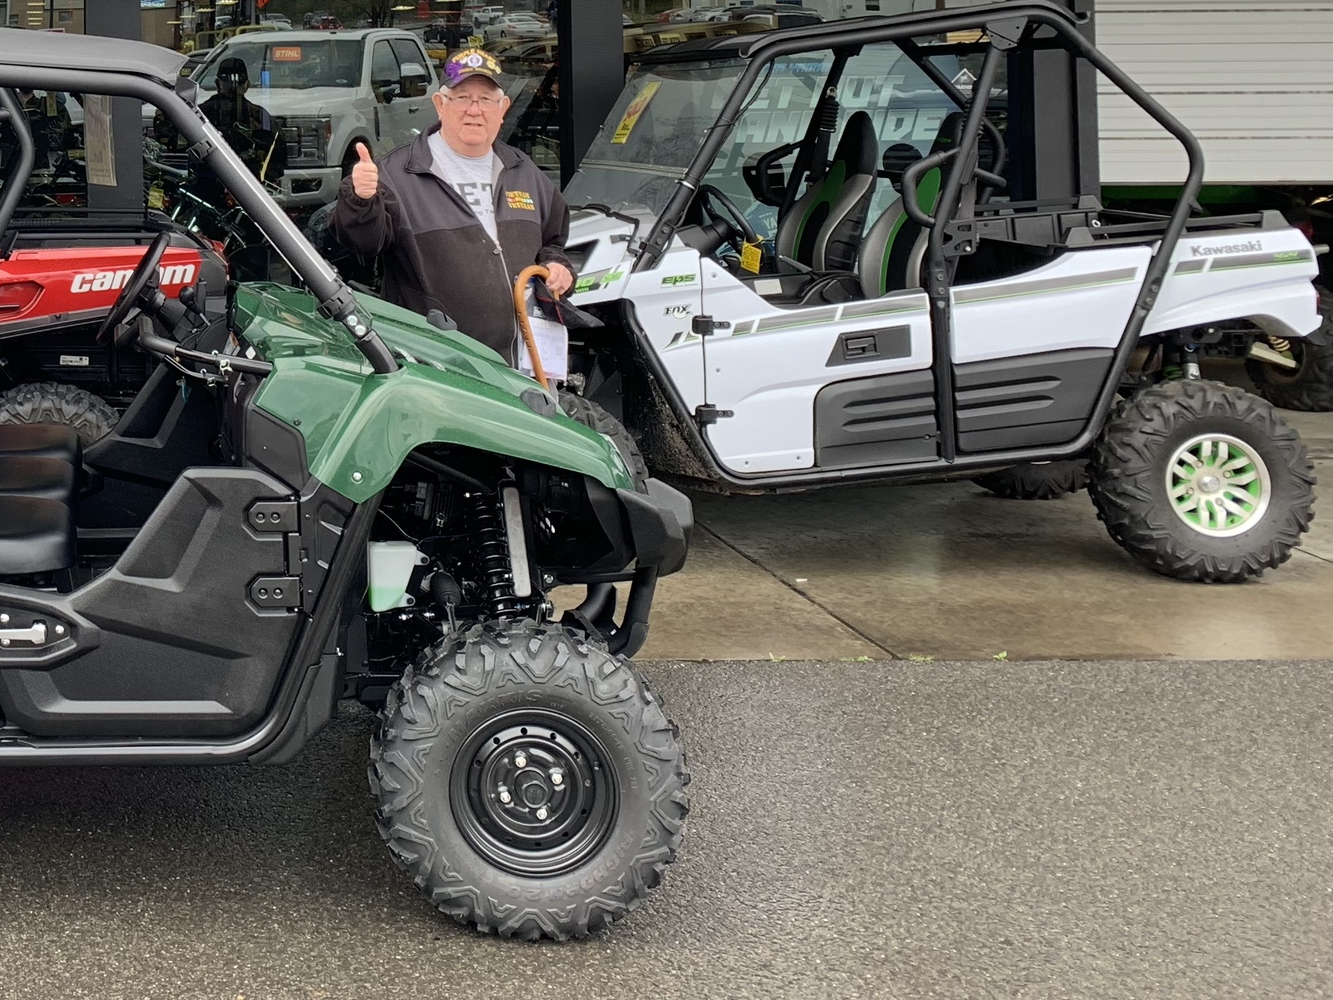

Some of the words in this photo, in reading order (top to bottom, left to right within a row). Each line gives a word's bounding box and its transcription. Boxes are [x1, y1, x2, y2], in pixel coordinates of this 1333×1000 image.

[275, 50, 300, 58] STIHL
[1190, 240, 1263, 257] Kawasaki
[664, 303, 692, 317] FOX
